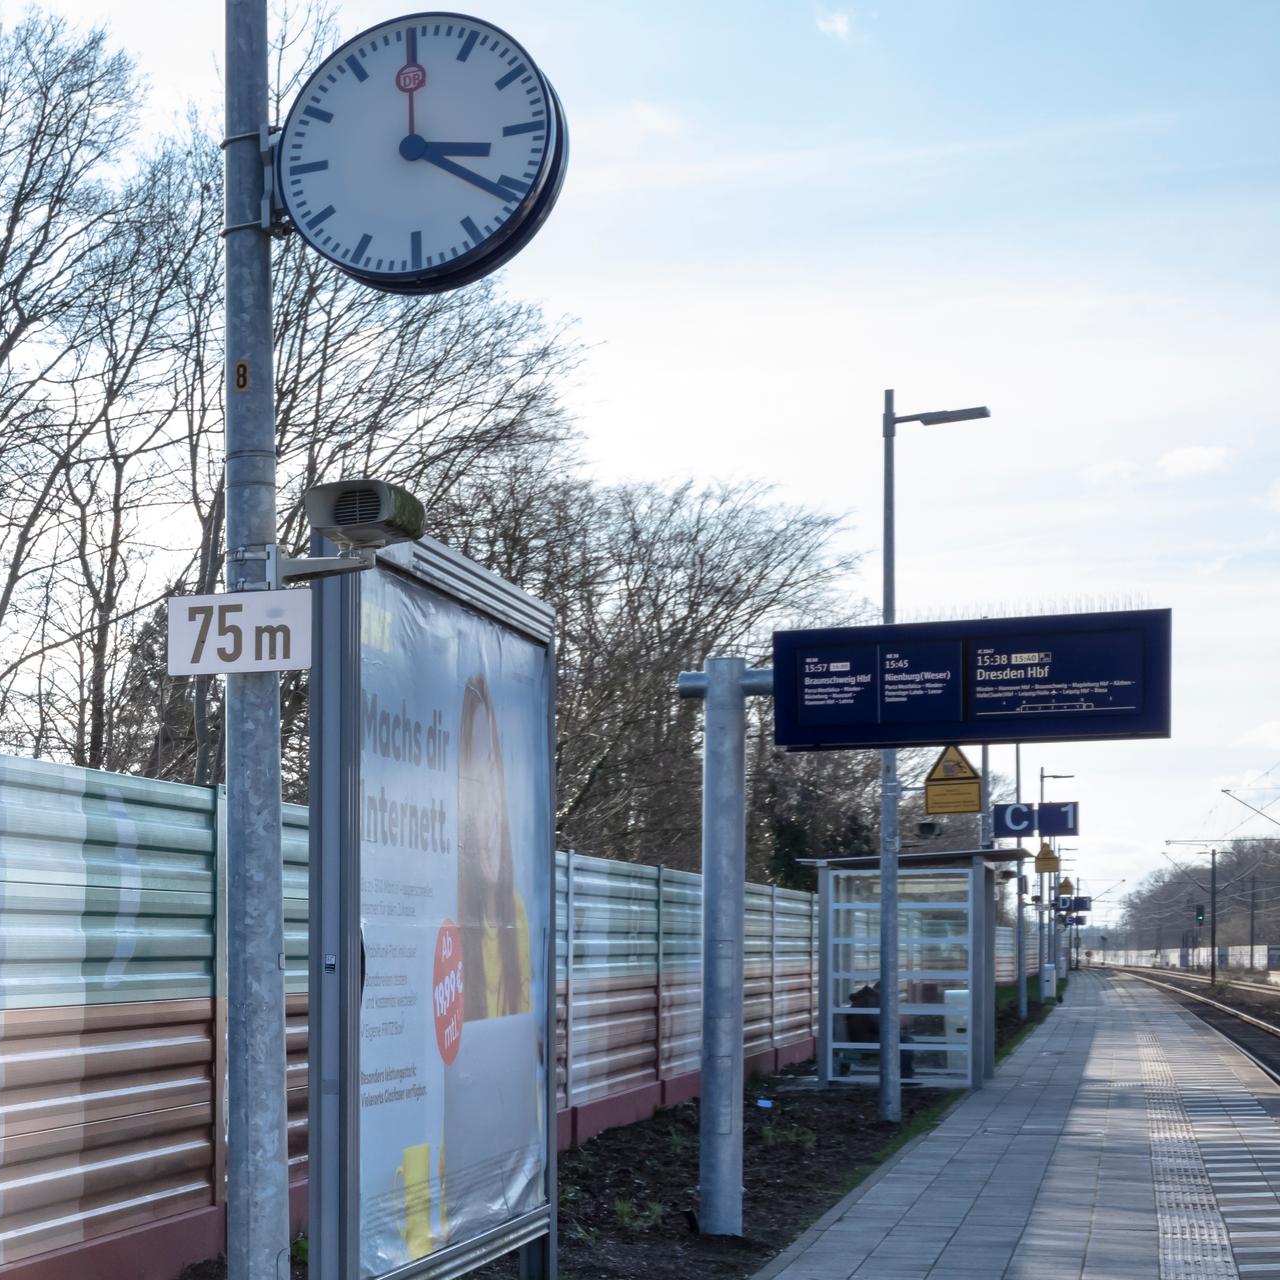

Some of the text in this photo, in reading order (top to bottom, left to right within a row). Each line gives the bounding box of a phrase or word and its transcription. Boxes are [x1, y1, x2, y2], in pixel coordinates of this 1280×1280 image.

[188, 603, 291, 664] 75 m
[805, 663, 828, 673] 15:57
[885, 659, 909, 669] 15:45
[976, 665, 1050, 681] Dresden Hbf
[977, 655, 1008, 666] 15:38
[856, 673, 872, 683] Hbf
[361, 688, 450, 772] Machs dir
[360, 779, 451, 855] Internett.
[1005, 804, 1029, 831] C
[1060, 803, 1074, 829] 1
[1059, 897, 1071, 910] D
[441, 930, 453, 962] Ab
[434, 960, 464, 1017] 19,99 €
